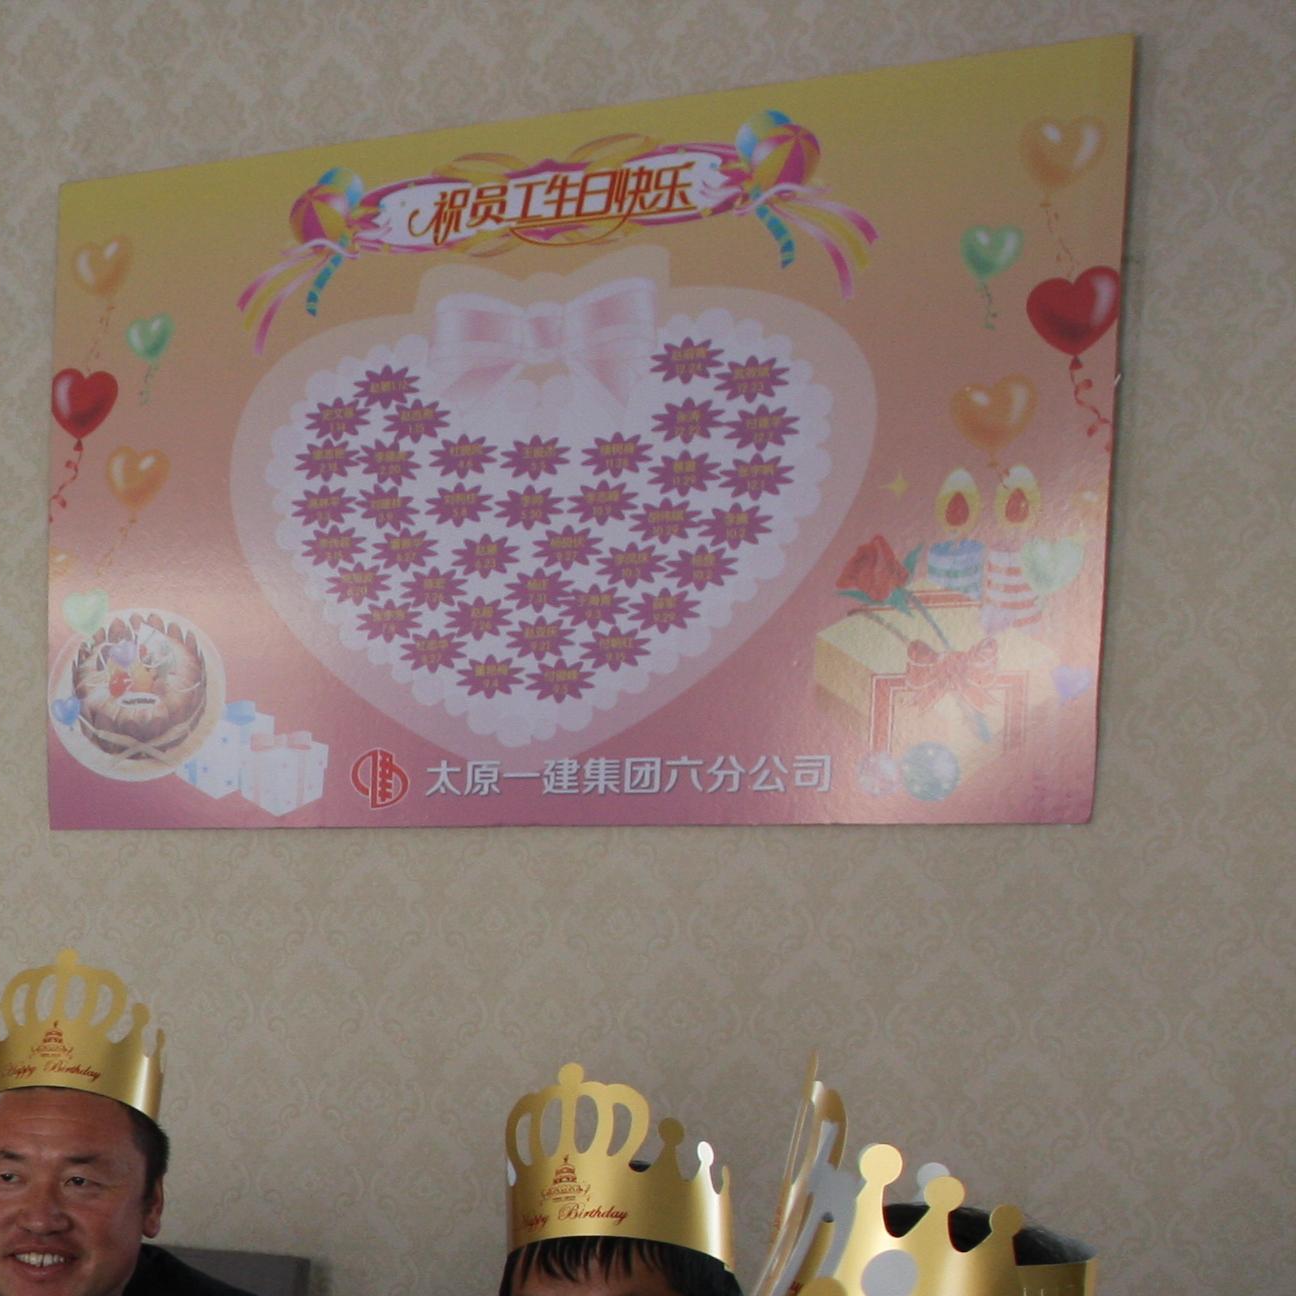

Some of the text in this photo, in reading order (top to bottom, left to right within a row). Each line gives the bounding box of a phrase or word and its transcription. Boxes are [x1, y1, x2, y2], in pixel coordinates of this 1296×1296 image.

[409, 160, 697, 246] 祝员工生日快乐
[424, 754, 833, 797] 太原一建集团六分公司
[43, 1057, 102, 1082] Birthday
[557, 1202, 629, 1227] Birthday
